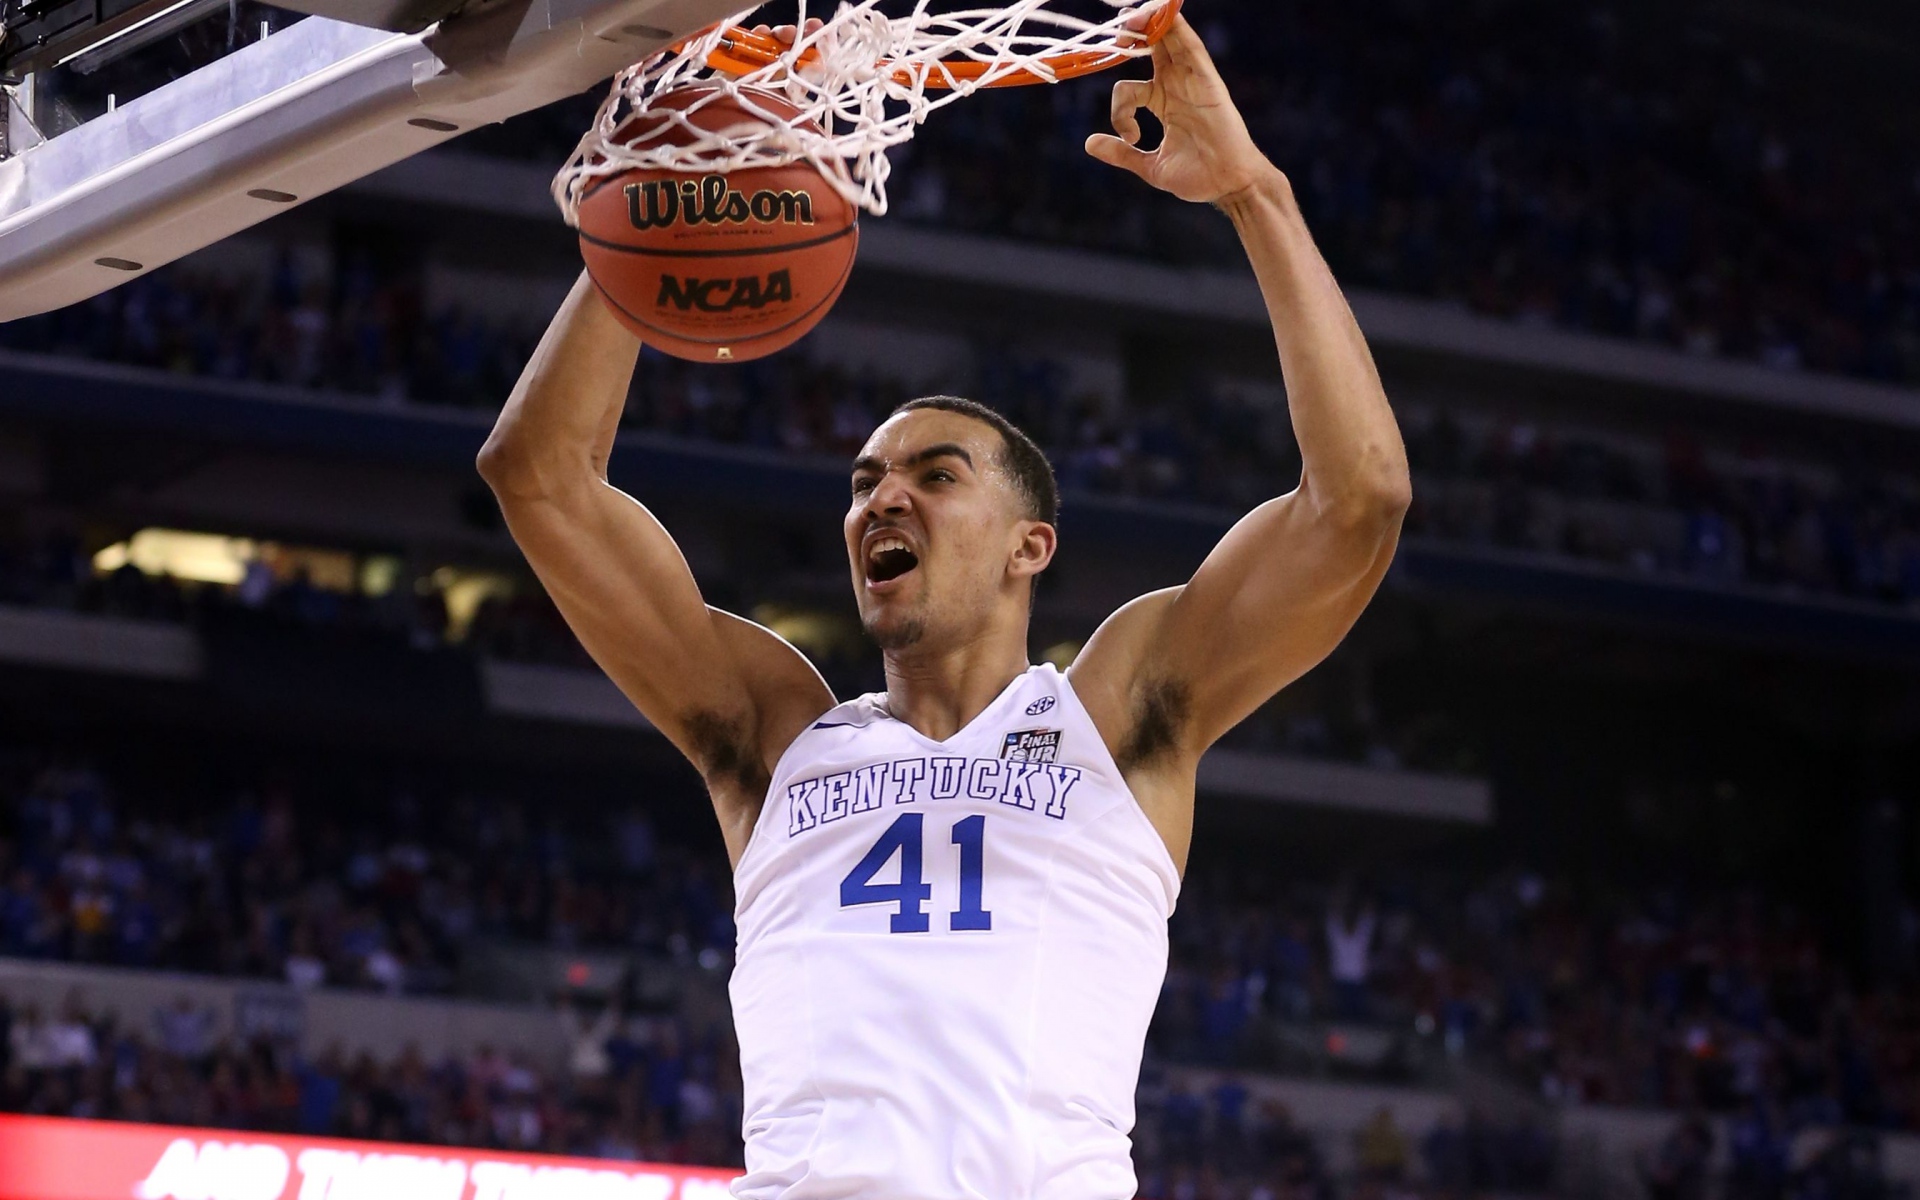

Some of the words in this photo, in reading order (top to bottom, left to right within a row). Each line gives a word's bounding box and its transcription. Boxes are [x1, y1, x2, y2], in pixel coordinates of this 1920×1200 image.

[623, 174, 814, 231] Wilson
[656, 267, 793, 312] NCAA
[1026, 696, 1055, 715] SEC
[1019, 733, 1056, 749] FINAL
[788, 757, 1081, 838] KENTUCKY
[840, 812, 992, 934] 41
